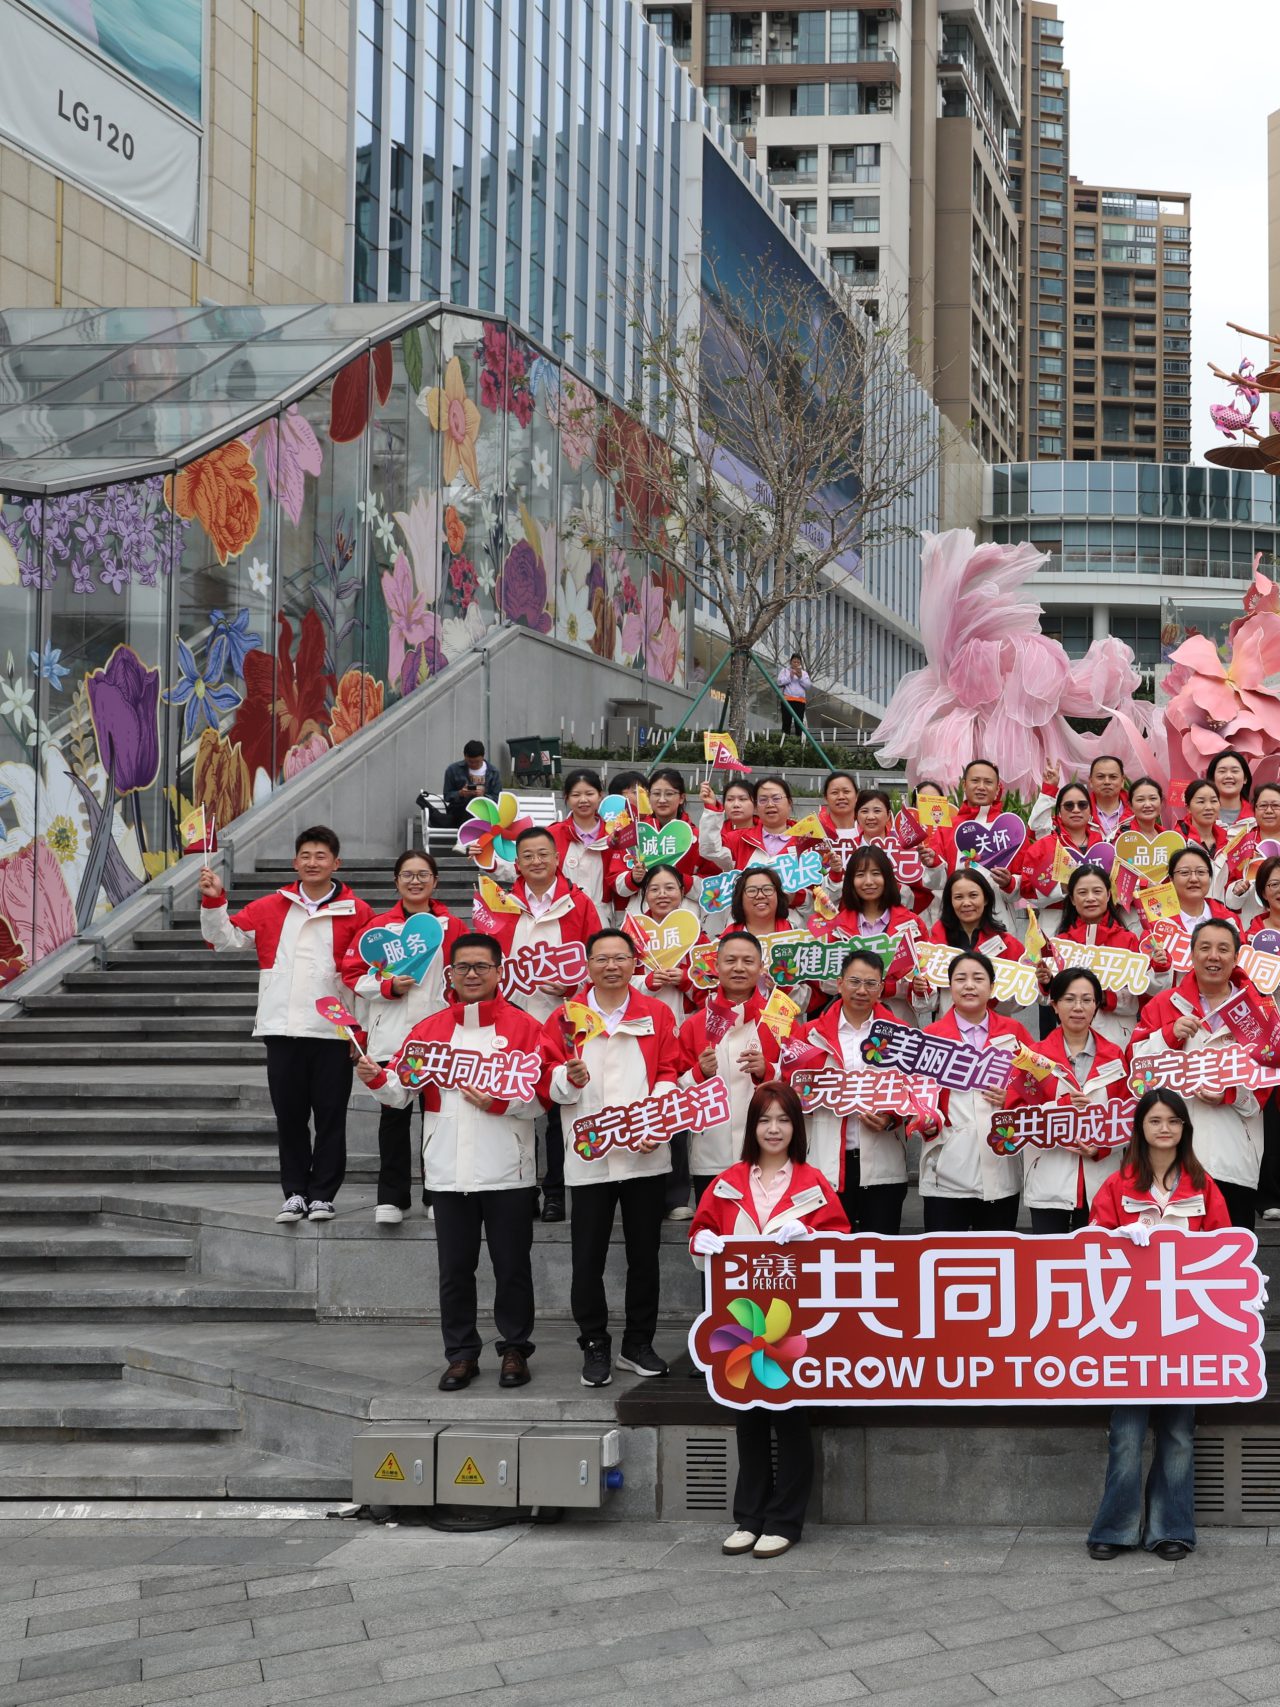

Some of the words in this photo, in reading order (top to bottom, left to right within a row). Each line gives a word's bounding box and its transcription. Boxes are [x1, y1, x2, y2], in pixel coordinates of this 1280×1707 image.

[58, 89, 134, 160] LG120
[643, 835, 676, 856] 诚信
[975, 828, 1010, 853] 关怀
[1133, 846, 1169, 865] 品质
[384, 933, 428, 963] 服务
[643, 926, 682, 951] 品质
[927, 946, 1038, 1001] 超平凡
[420, 1046, 535, 1098] 共同成长
[882, 1030, 1013, 1088] 美丽自信
[808, 1071, 936, 1113] 完美生活
[594, 1082, 726, 1151] 完美生活
[1014, 1103, 1134, 1147] 共同成长
[752, 1252, 797, 1277] 完美
[752, 1277, 797, 1291] PERFECT
[798, 1242, 1248, 1340] 共同成长
[792, 1355, 926, 1390] GROW
[936, 1356, 995, 1388] UP
[1005, 1354, 1250, 1388] TOGETHER
